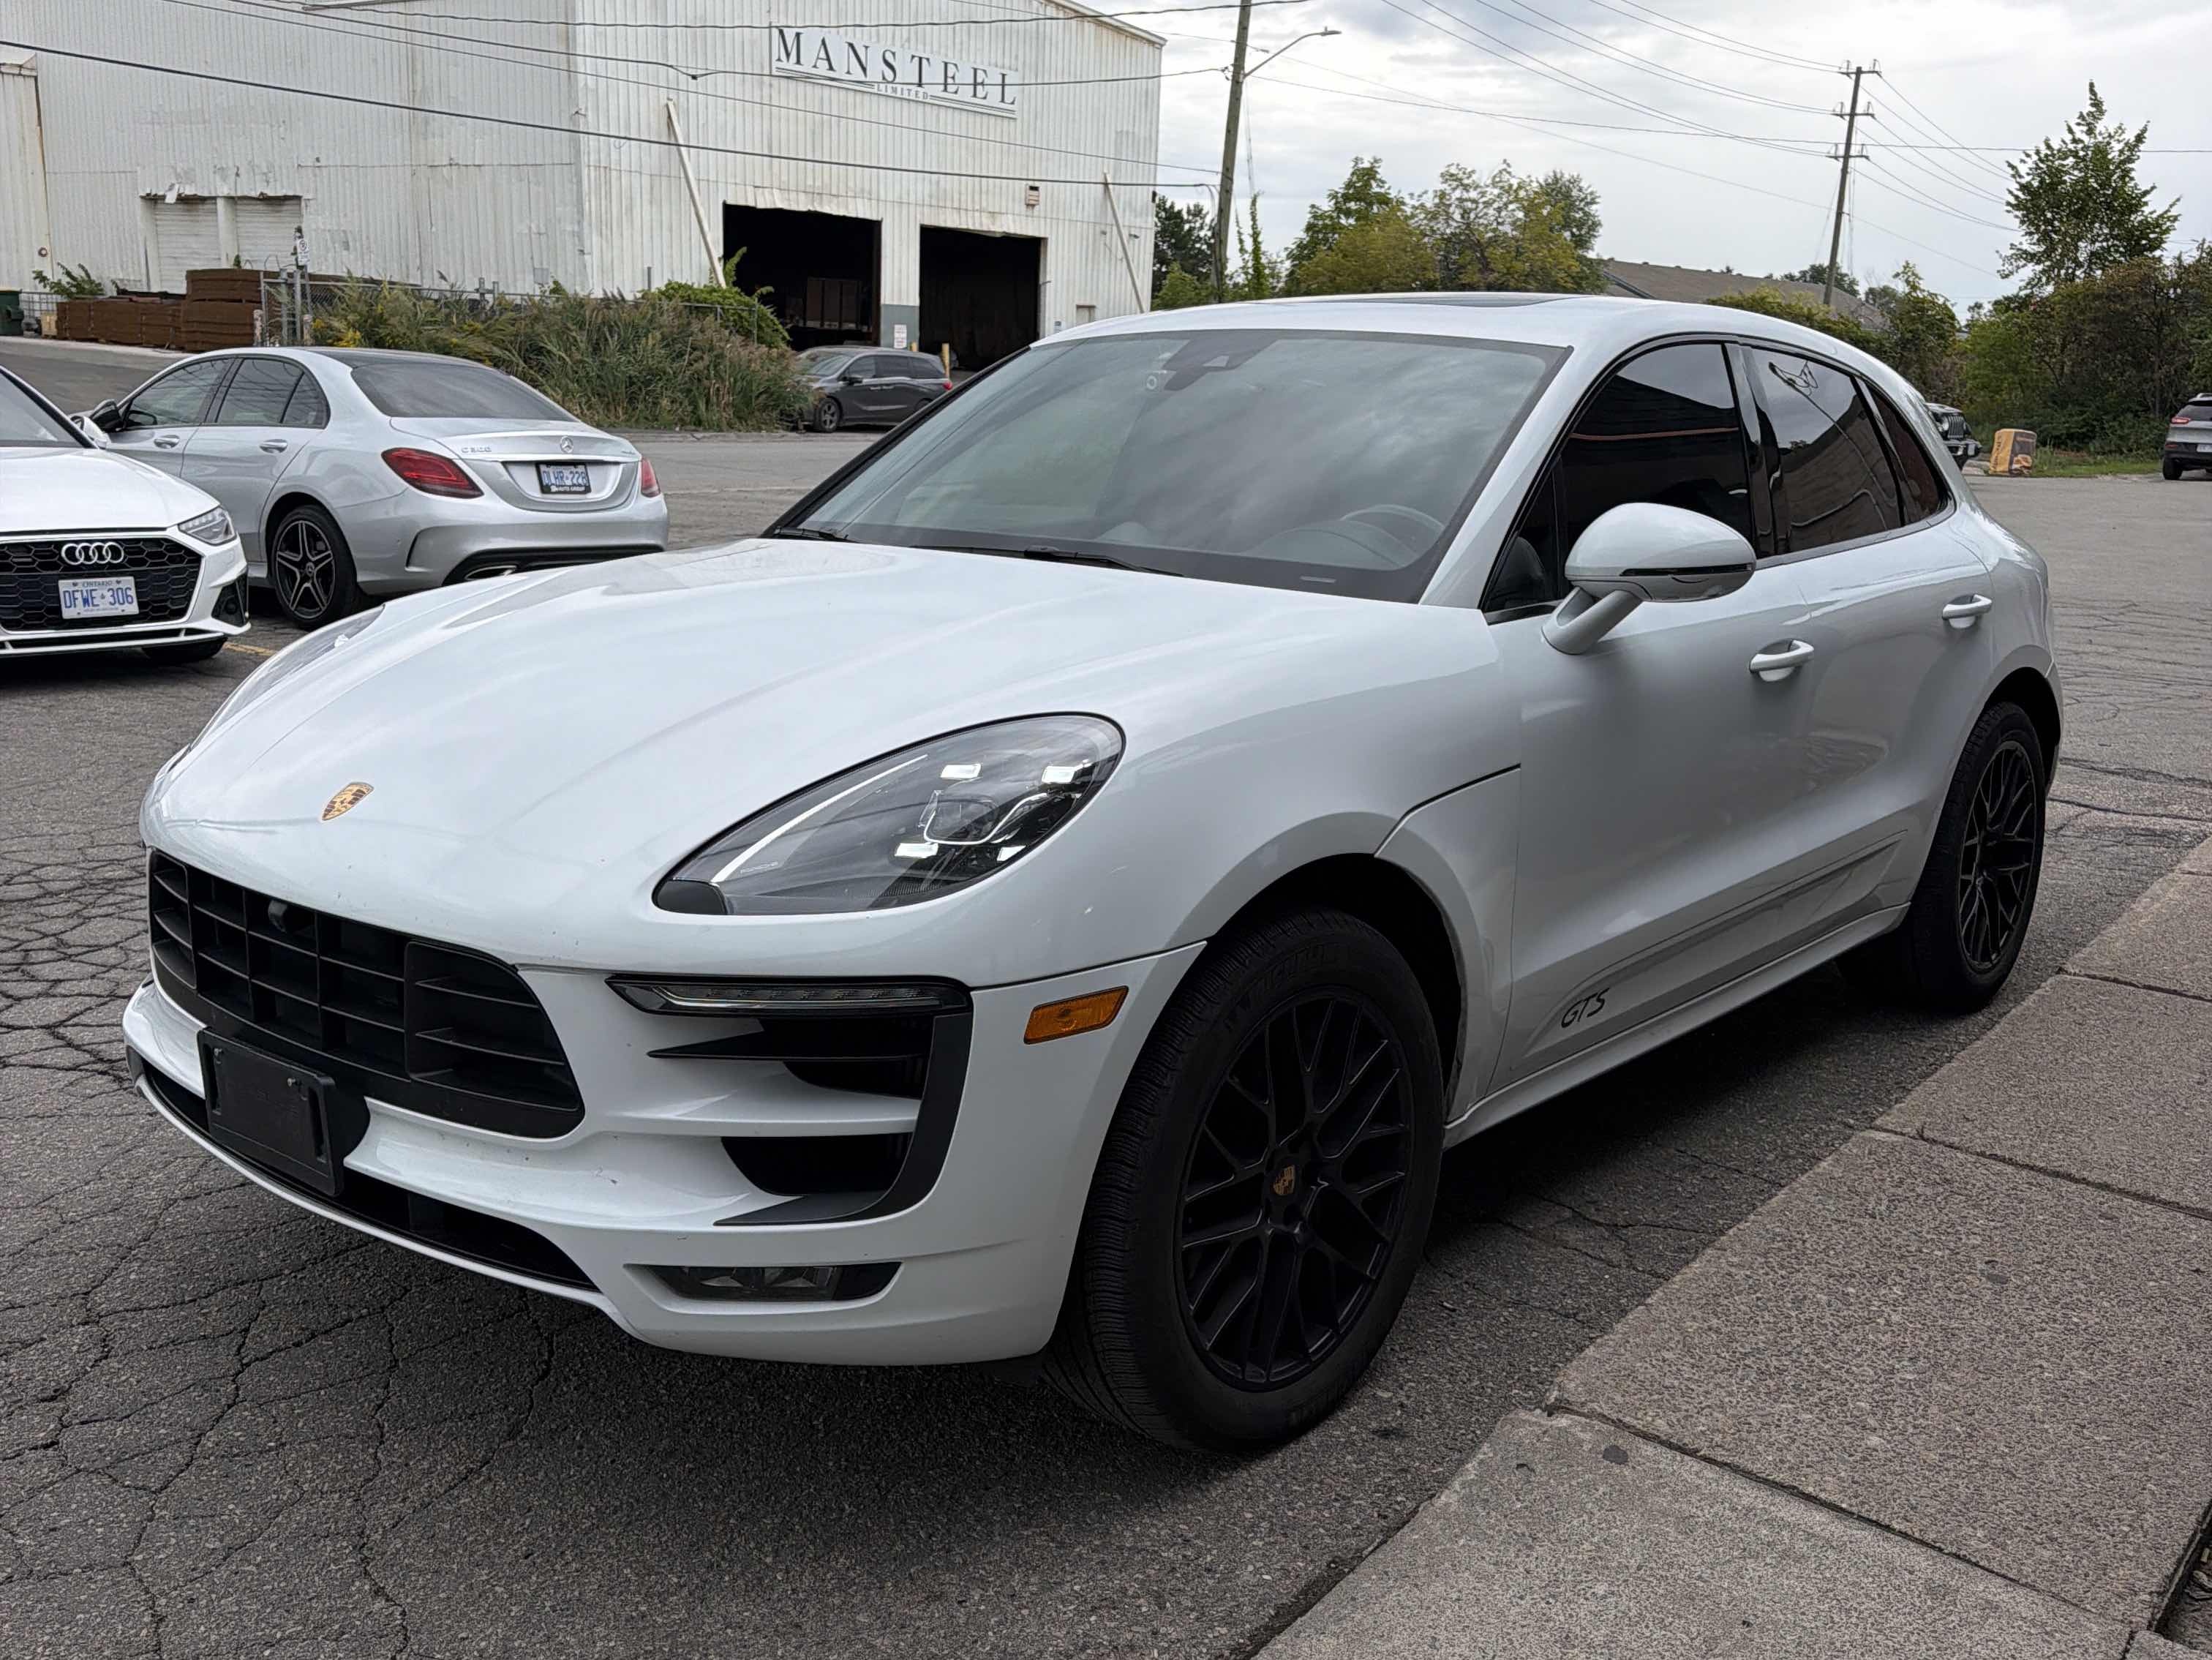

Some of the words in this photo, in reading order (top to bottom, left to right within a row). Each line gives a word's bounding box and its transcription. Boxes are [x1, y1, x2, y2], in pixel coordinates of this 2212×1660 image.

[775, 28, 1016, 105] MANSTEEL
[877, 83, 928, 99] LIMITED
[63, 588, 100, 609] DFWE
[107, 587, 134, 606] 306
[1561, 987, 1611, 1028] GTS
